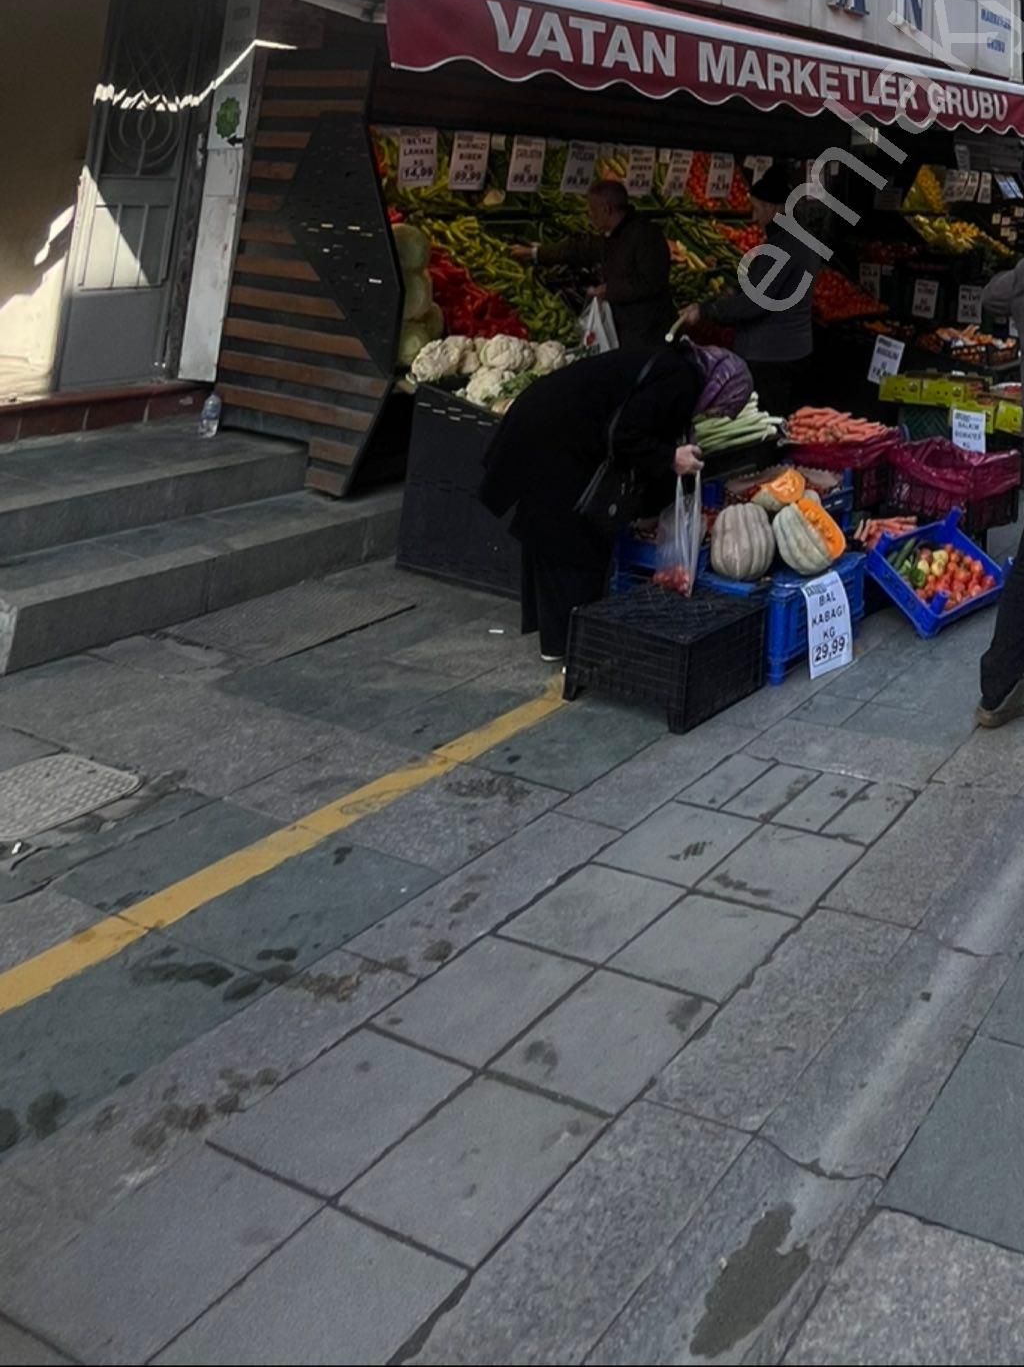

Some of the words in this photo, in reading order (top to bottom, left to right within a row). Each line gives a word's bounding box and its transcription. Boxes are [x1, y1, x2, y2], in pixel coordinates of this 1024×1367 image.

[699, 41, 918, 112] MARKETLER
[925, 84, 1009, 123] GRUBU
[819, 590, 837, 607] BAL
[823, 626, 837, 640] KG
[814, 635, 846, 663] 29,99
